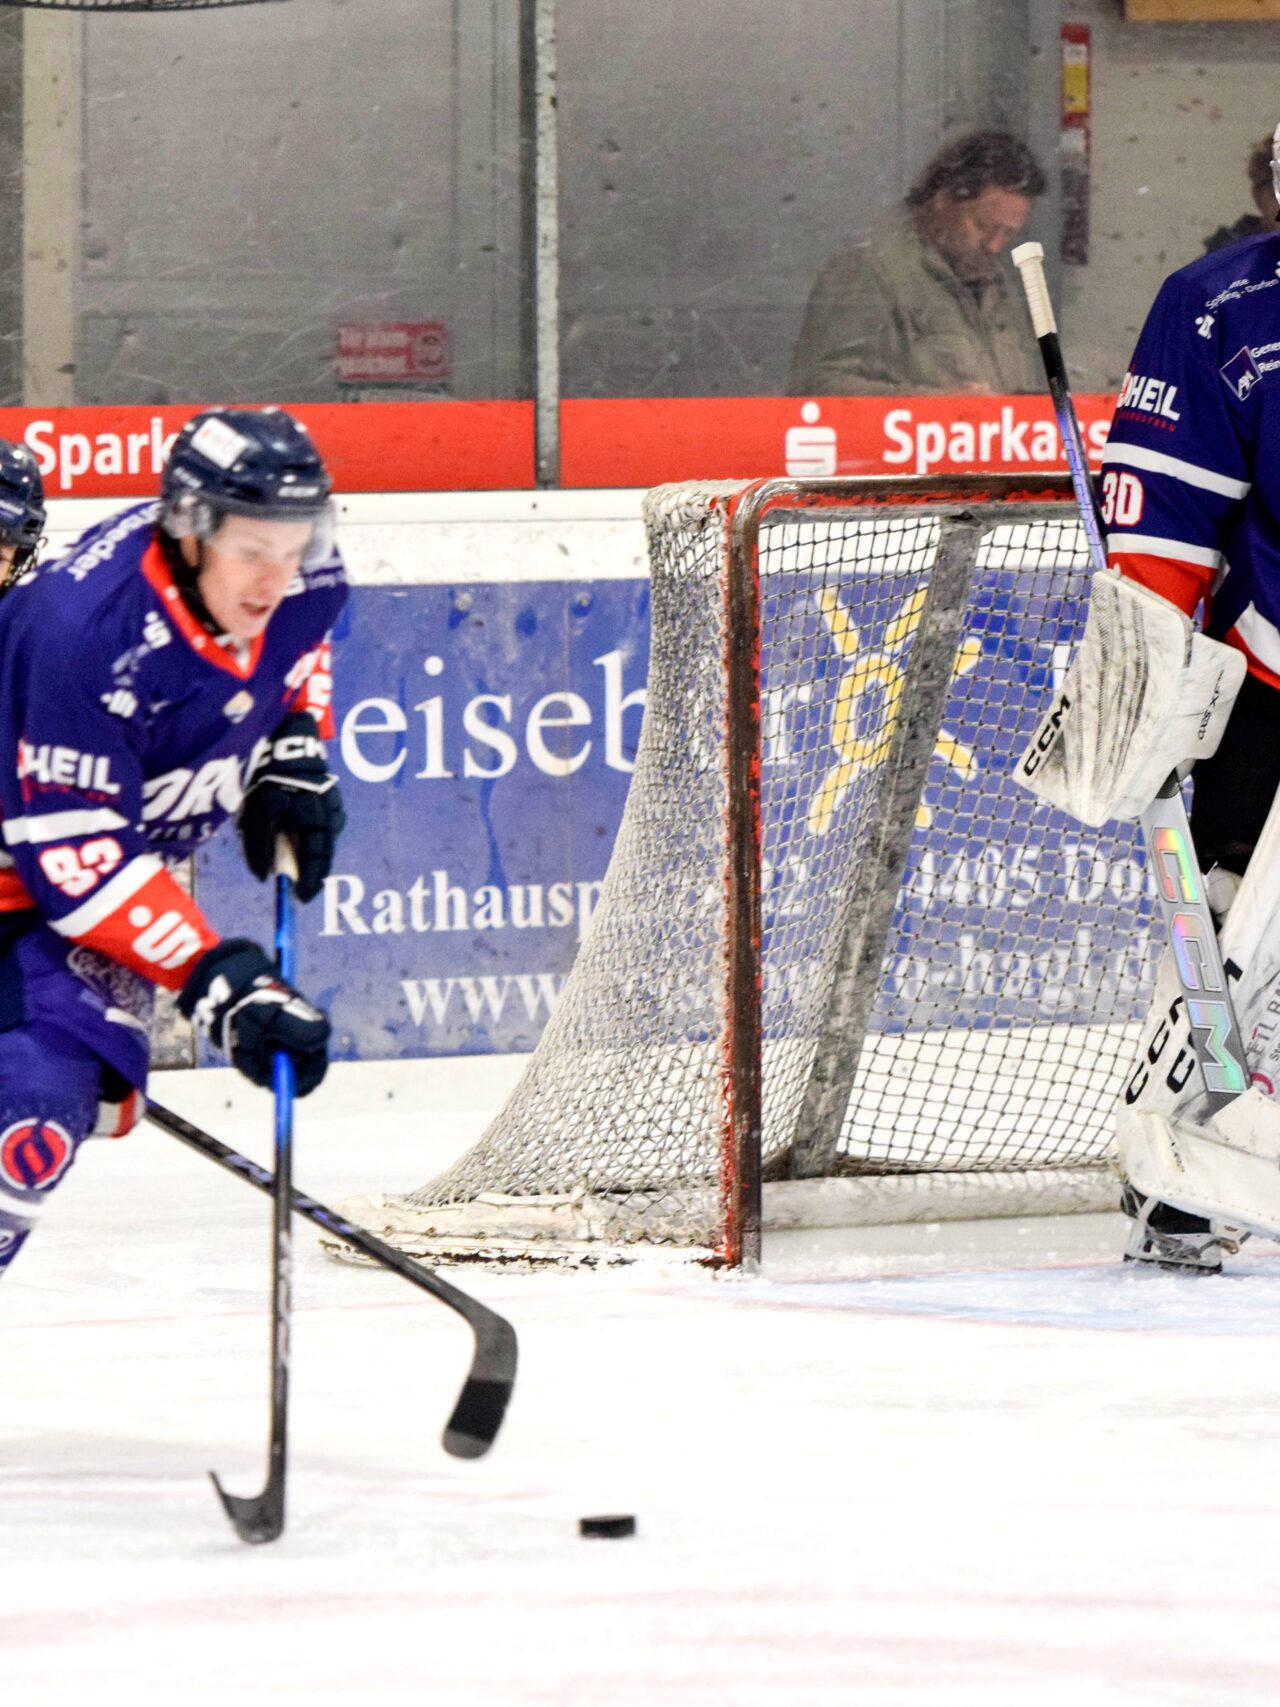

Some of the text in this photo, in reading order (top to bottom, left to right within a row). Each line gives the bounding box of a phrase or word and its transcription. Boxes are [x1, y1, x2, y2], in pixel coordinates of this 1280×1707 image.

[23, 416, 176, 490] Spark
[882, 405, 1112, 474] Sparkas
[1101, 471, 1144, 527] 30
[340, 650, 649, 784] eiseb
[1023, 694, 1071, 777] CCM
[17, 739, 121, 795] HEIL
[318, 870, 606, 942] Rathausp
